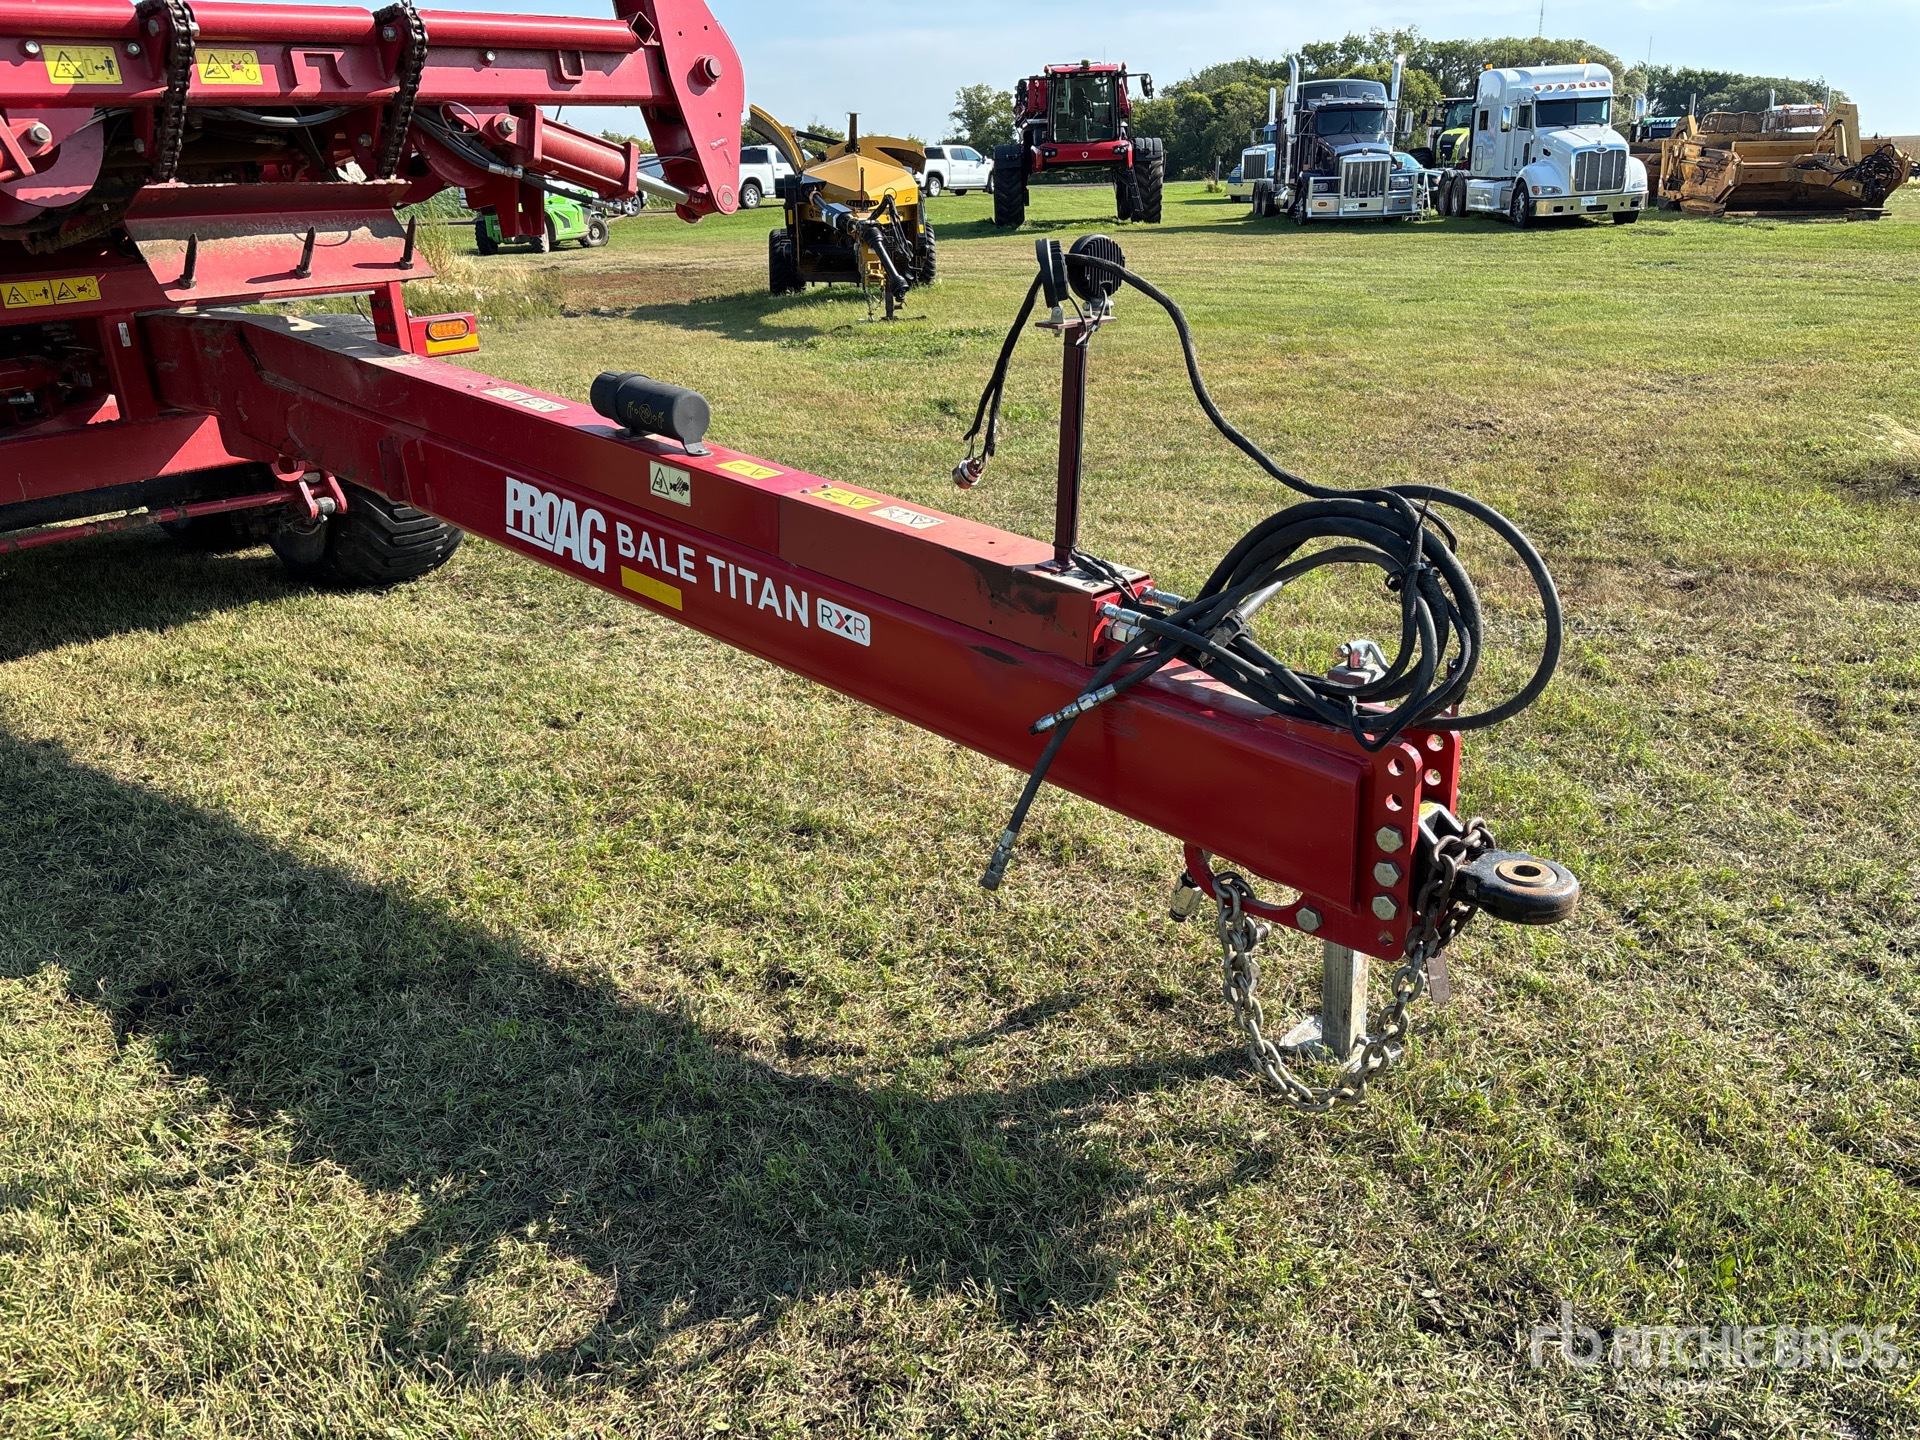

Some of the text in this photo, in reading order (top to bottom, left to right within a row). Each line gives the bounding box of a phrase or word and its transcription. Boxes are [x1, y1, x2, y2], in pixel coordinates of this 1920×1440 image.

[506, 477, 866, 640] PROAG BALE TITAN RXR
